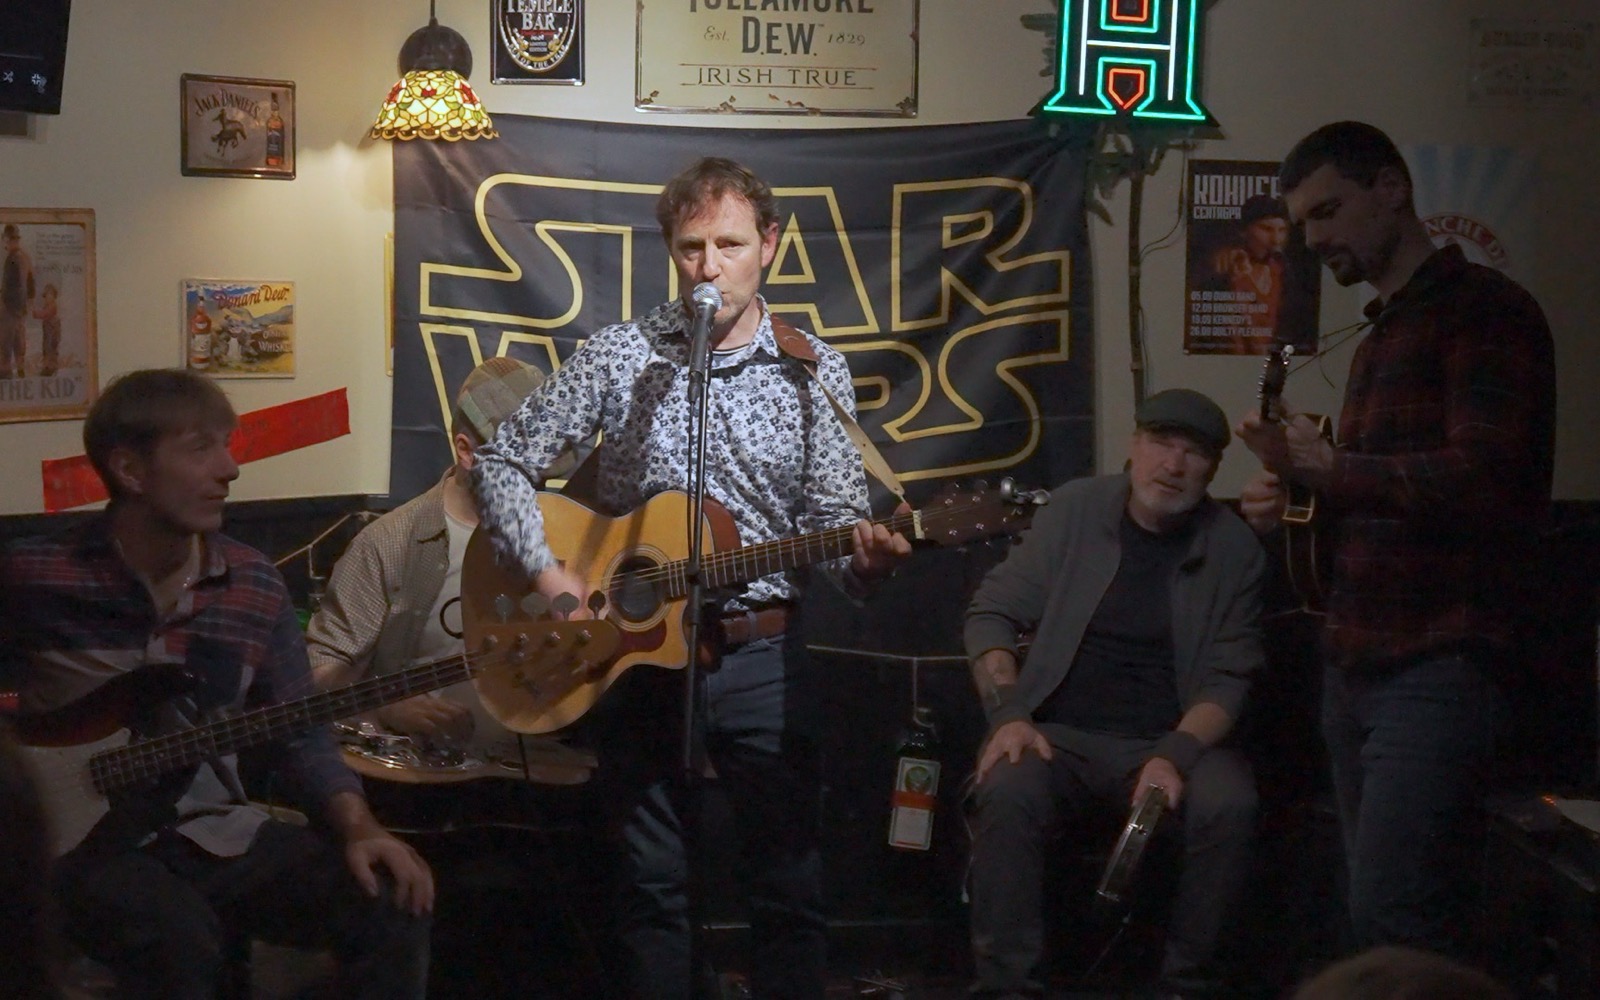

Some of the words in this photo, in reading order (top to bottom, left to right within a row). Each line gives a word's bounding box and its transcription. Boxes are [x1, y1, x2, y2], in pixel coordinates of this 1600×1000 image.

[521, 12, 556, 30] BAR
[703, 25, 730, 42] Est.
[827, 33, 867, 46] 1829
[533, 60, 549, 69] THE
[698, 67, 773, 86] IRISH
[787, 68, 857, 89] TRUE
[195, 93, 221, 117] JACK
[220, 88, 261, 119] DANIEL'S
[419, 172, 1071, 347] STAR
[0, 379, 34, 402] THE
